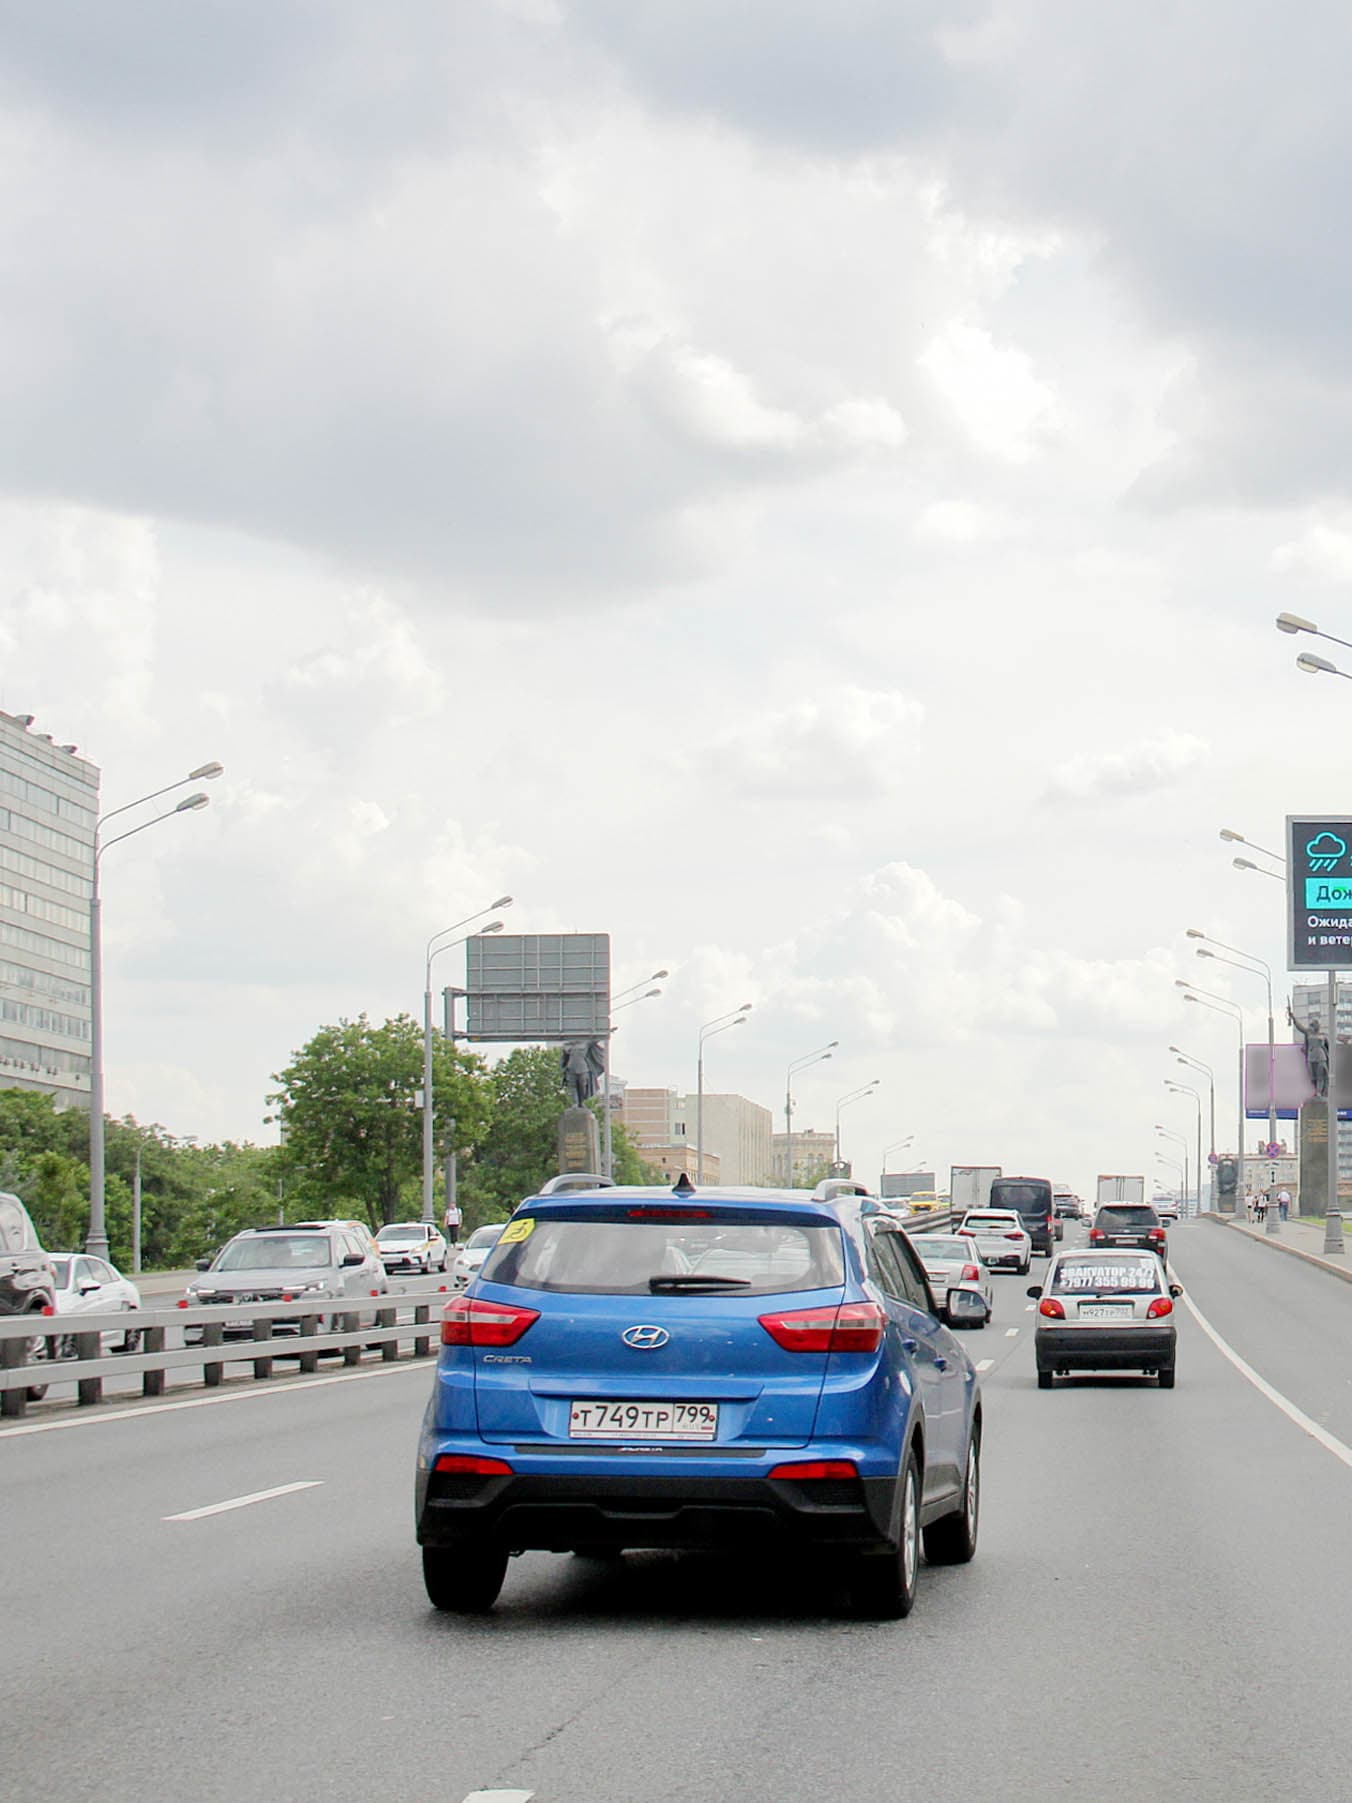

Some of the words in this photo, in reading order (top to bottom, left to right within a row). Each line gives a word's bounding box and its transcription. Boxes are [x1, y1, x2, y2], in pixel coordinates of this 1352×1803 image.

[1308, 935, 1316, 945] и
[1060, 1266, 1126, 1279] ЭВАКУАТОР
[1095, 1277, 1118, 1288] 355
[483, 1354, 533, 1364] CRETA
[675, 1405, 711, 1424] 799
